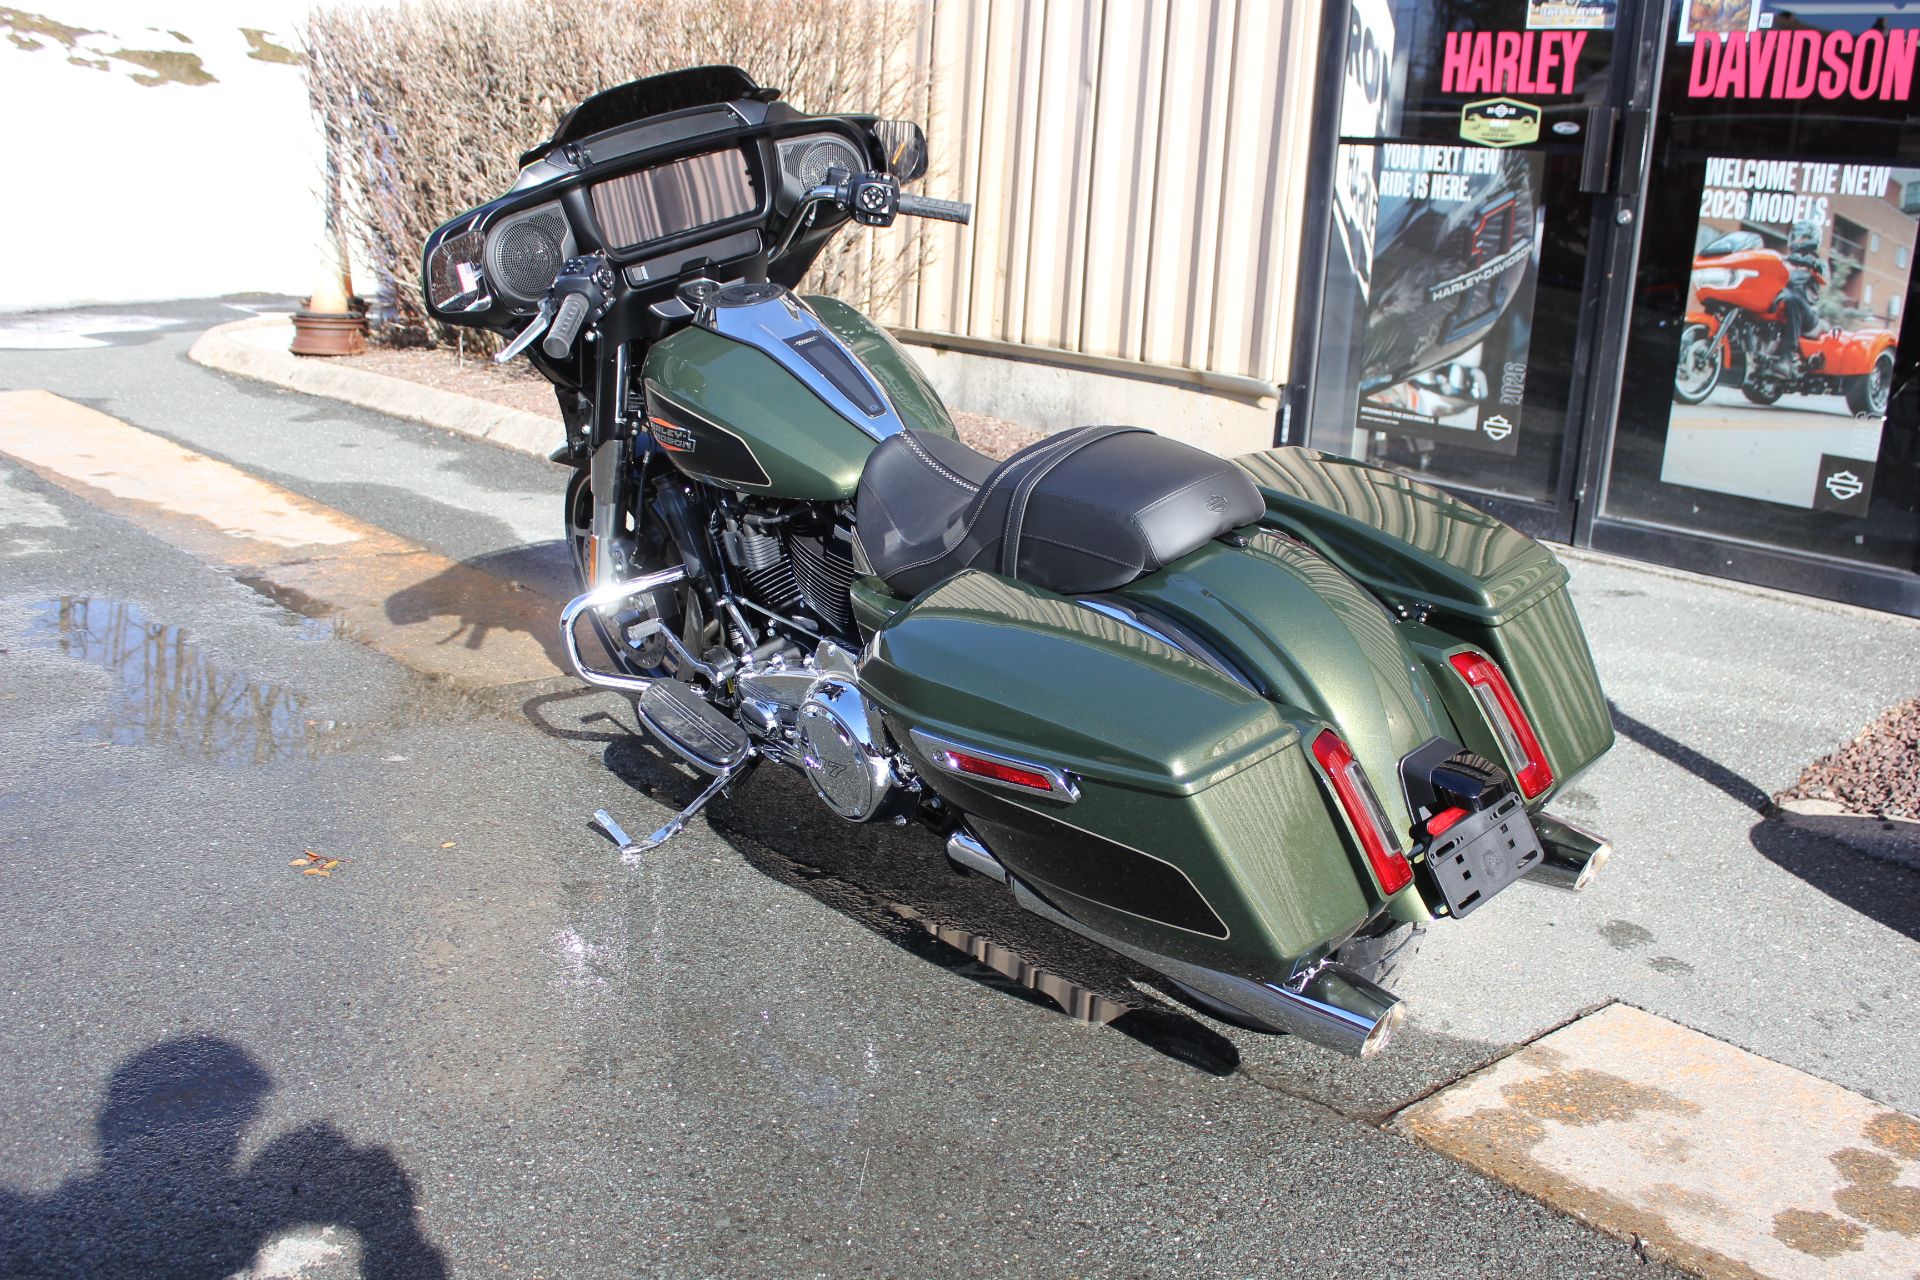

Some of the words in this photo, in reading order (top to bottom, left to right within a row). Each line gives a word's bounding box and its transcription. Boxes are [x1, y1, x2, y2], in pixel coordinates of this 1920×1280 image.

[1441, 31, 1588, 95] HARLEY
[1688, 29, 1919, 100] DAVIDSON
[1382, 143, 1420, 169] YOUR
[1422, 145, 1461, 173] NEXT
[1463, 148, 1500, 175] NEW
[1705, 157, 1799, 192] WELCOME
[1801, 162, 1840, 194] THE
[1840, 165, 1891, 197] NEW
[1379, 170, 1412, 198] RIDE
[1413, 173, 1429, 199] IS
[1430, 174, 1472, 202] HERE.
[1699, 189, 1748, 220] 2026
[1750, 192, 1831, 227] MODELS.
[1433, 242, 1534, 302] HARLEY-DAVIDSON
[1500, 361, 1527, 406] 2026
